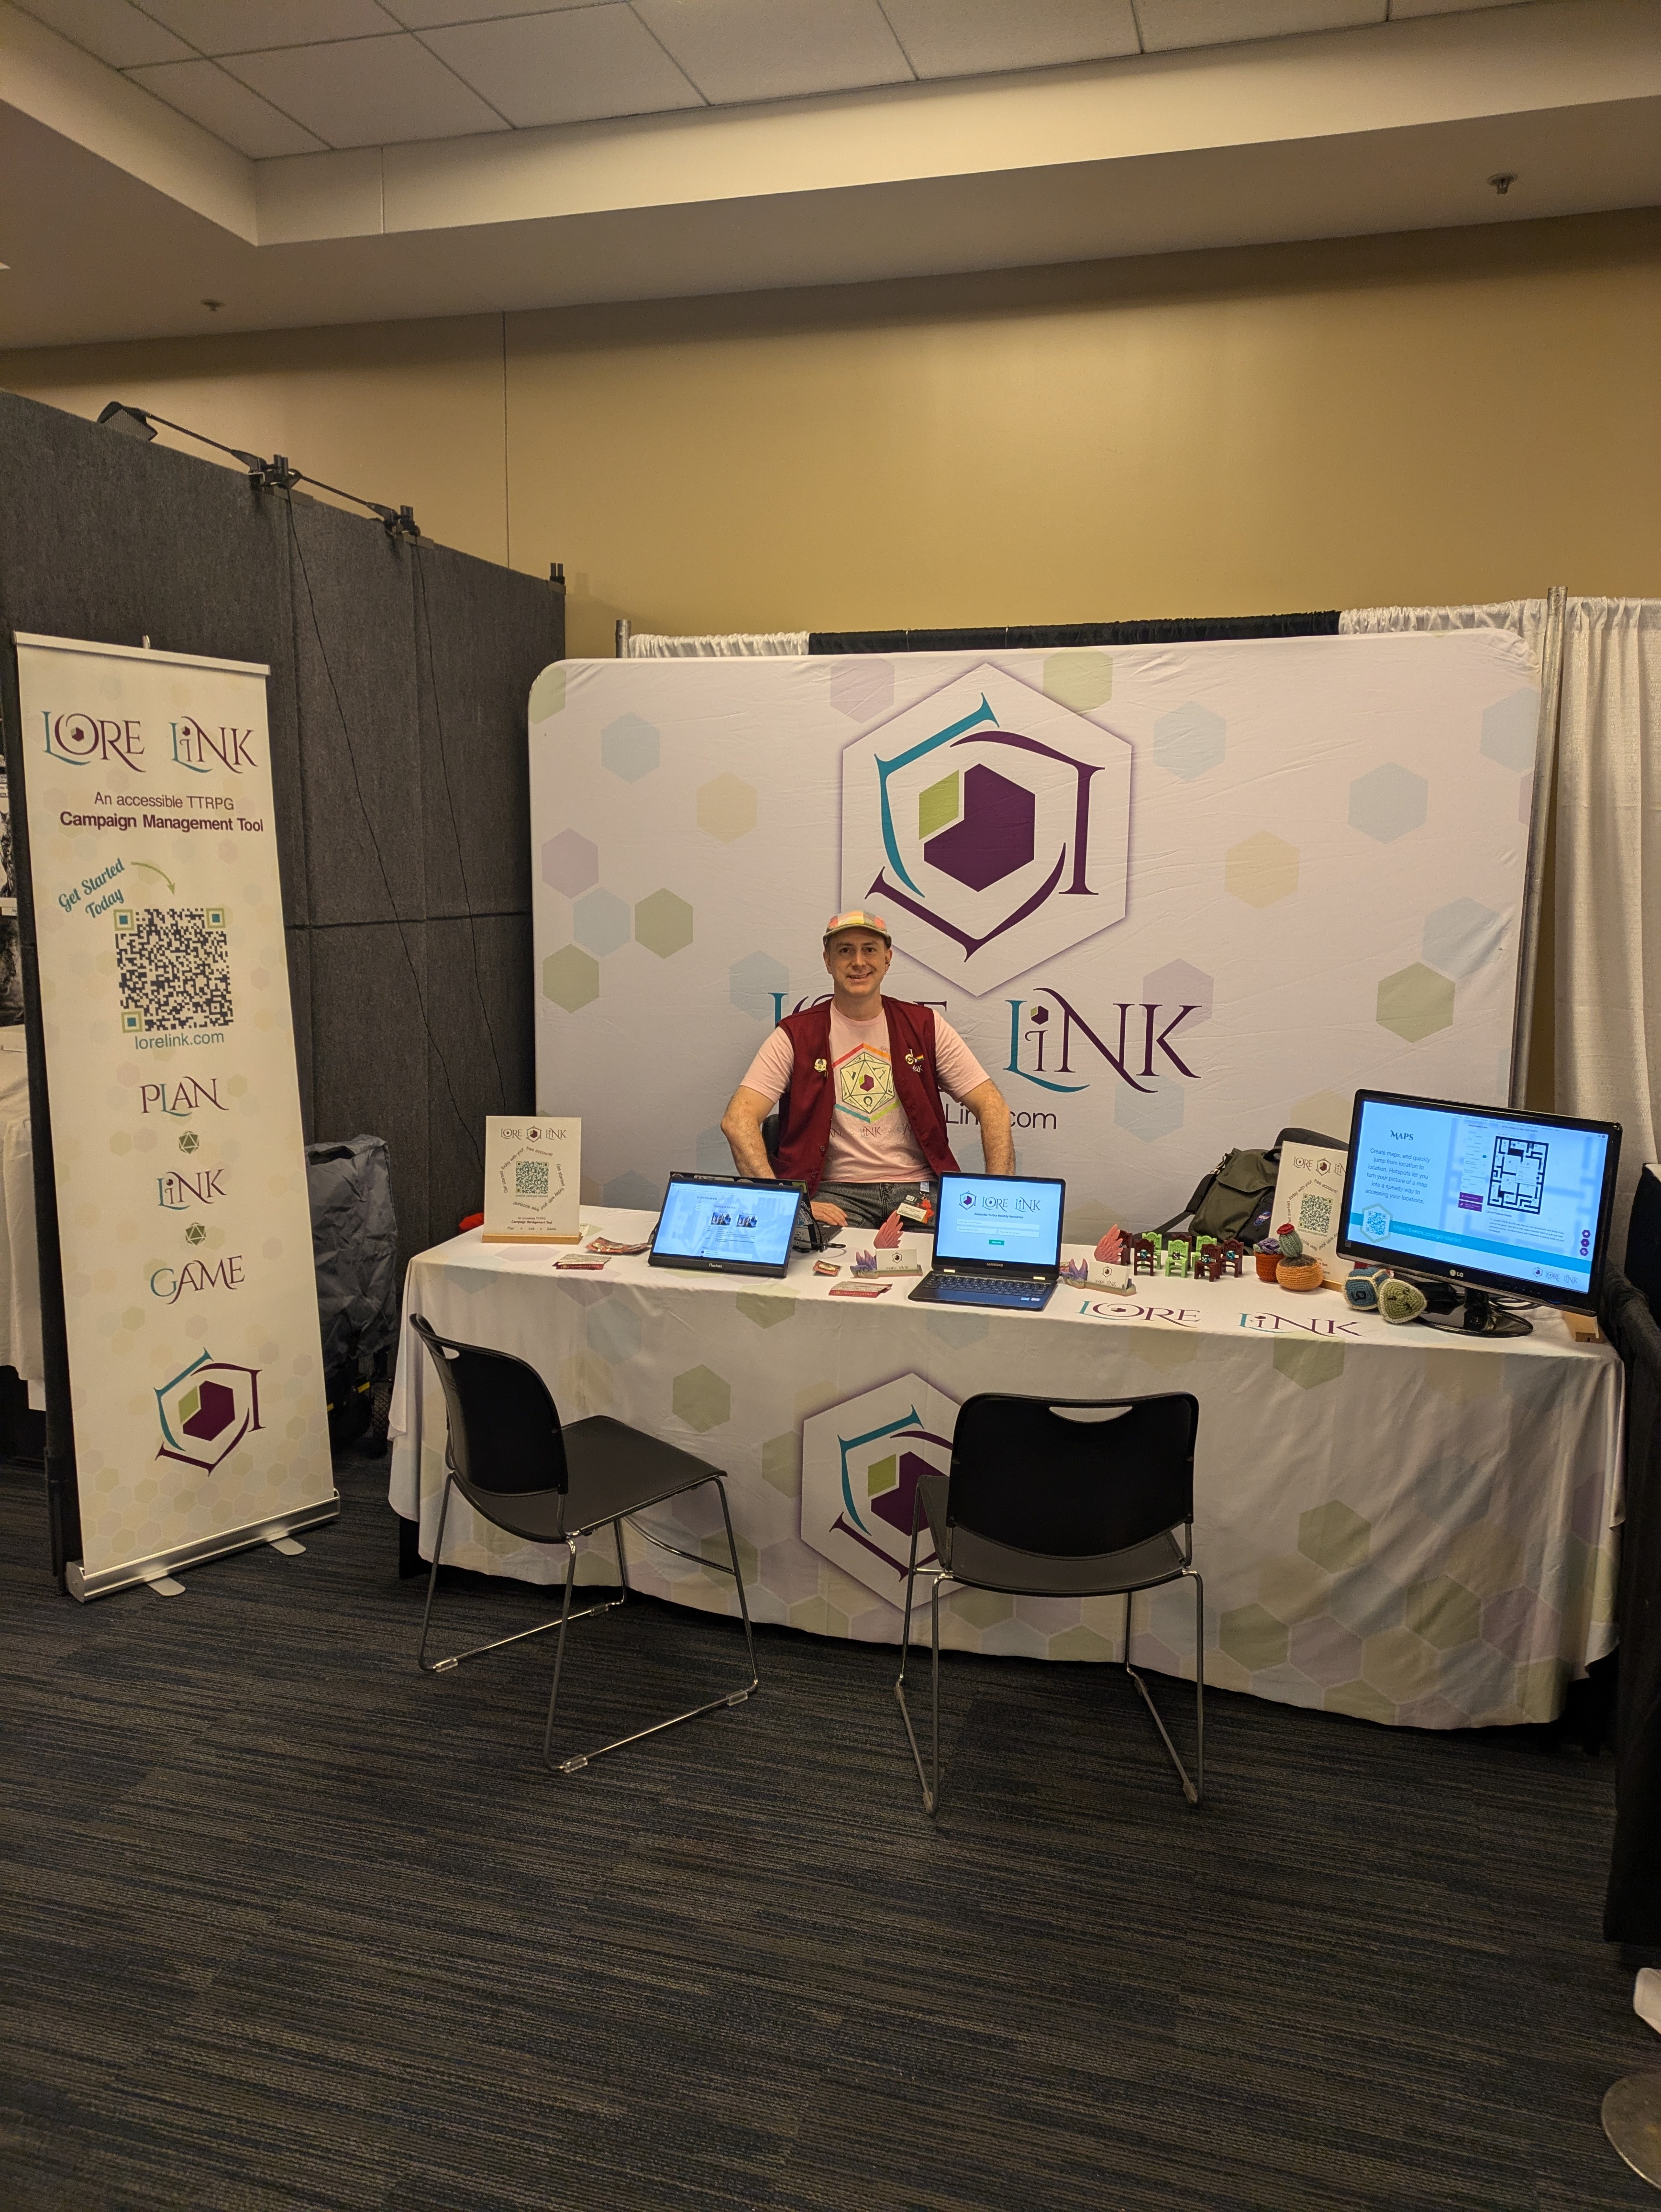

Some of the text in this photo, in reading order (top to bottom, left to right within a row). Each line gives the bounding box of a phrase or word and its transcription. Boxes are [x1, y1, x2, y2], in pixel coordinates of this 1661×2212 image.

[41, 711, 146, 772] LORE
[95, 791, 234, 810] An accessible TTRPG
[60, 811, 264, 832] Campaign Management Tool
[58, 858, 125, 912] Get Started
[84, 888, 125, 919] Today
[134, 1030, 225, 1050] lorelink.com
[139, 1076, 230, 1117] PLAN
[500, 1128, 522, 1140] LORE
[1390, 1130, 1414, 1141] MAPS
[501, 1160, 510, 1170] today
[516, 1148, 524, 1157] your
[1293, 1156, 1313, 1171] LORE
[1399, 1161, 1418, 1169] location
[1413, 1154, 1430, 1164] quickly
[1389, 1168, 1411, 1177] Hotspots
[555, 1187, 565, 1197] today
[1288, 1191, 1298, 1200] today
[1322, 1183, 1339, 1194] account!
[1365, 1189, 1389, 1198] accessing
[1401, 1194, 1425, 1204] locations.
[1385, 1184, 1404, 1193] speedy
[982, 1196, 1008, 1212] LORE
[1394, 1225, 1461, 1243] https://lorelink.com/get-started
[150, 1255, 245, 1305] GAME
[1545, 1271, 1560, 1282] LORE
[1074, 1300, 1201, 1328] LORE
